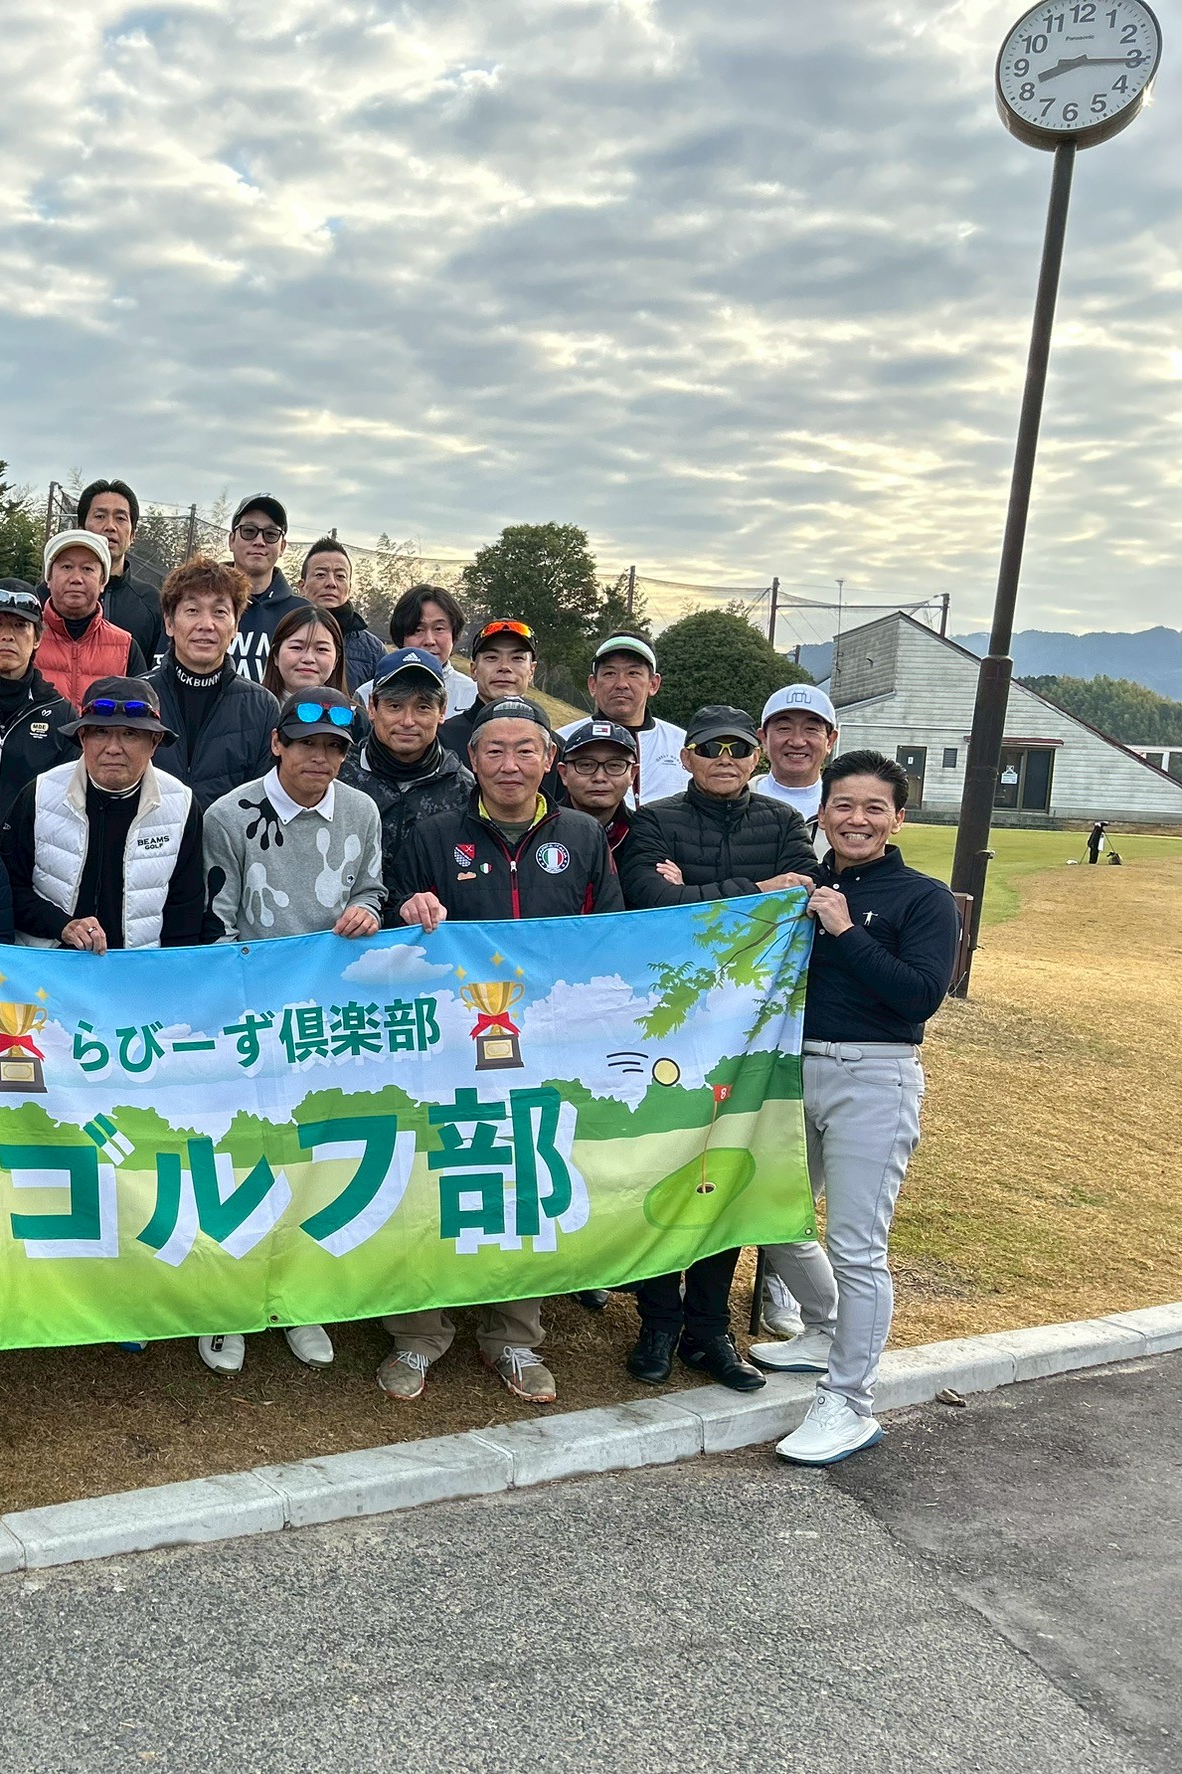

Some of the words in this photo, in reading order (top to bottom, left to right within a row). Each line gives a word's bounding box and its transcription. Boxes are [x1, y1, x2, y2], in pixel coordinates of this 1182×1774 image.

[1043, 13, 1065, 33] 11
[1069, 3, 1097, 24] 12
[1106, 9, 1117, 28] 1
[1120, 24, 1138, 44] 2
[1021, 34, 1048, 54] 10
[1013, 58, 1030, 77] 9
[1124, 49, 1143, 69] 3
[1019, 82, 1035, 101] 8
[1112, 75, 1128, 94] 4
[1039, 98, 1056, 117] 7
[1062, 102, 1079, 121] 6
[1090, 93, 1107, 113] 5
[137, 835, 170, 847] BEAMS
[144, 842, 164, 851] GOLF
[71, 997, 442, 1074] らびーず倶楽部
[720, 1087, 728, 1100] 8
